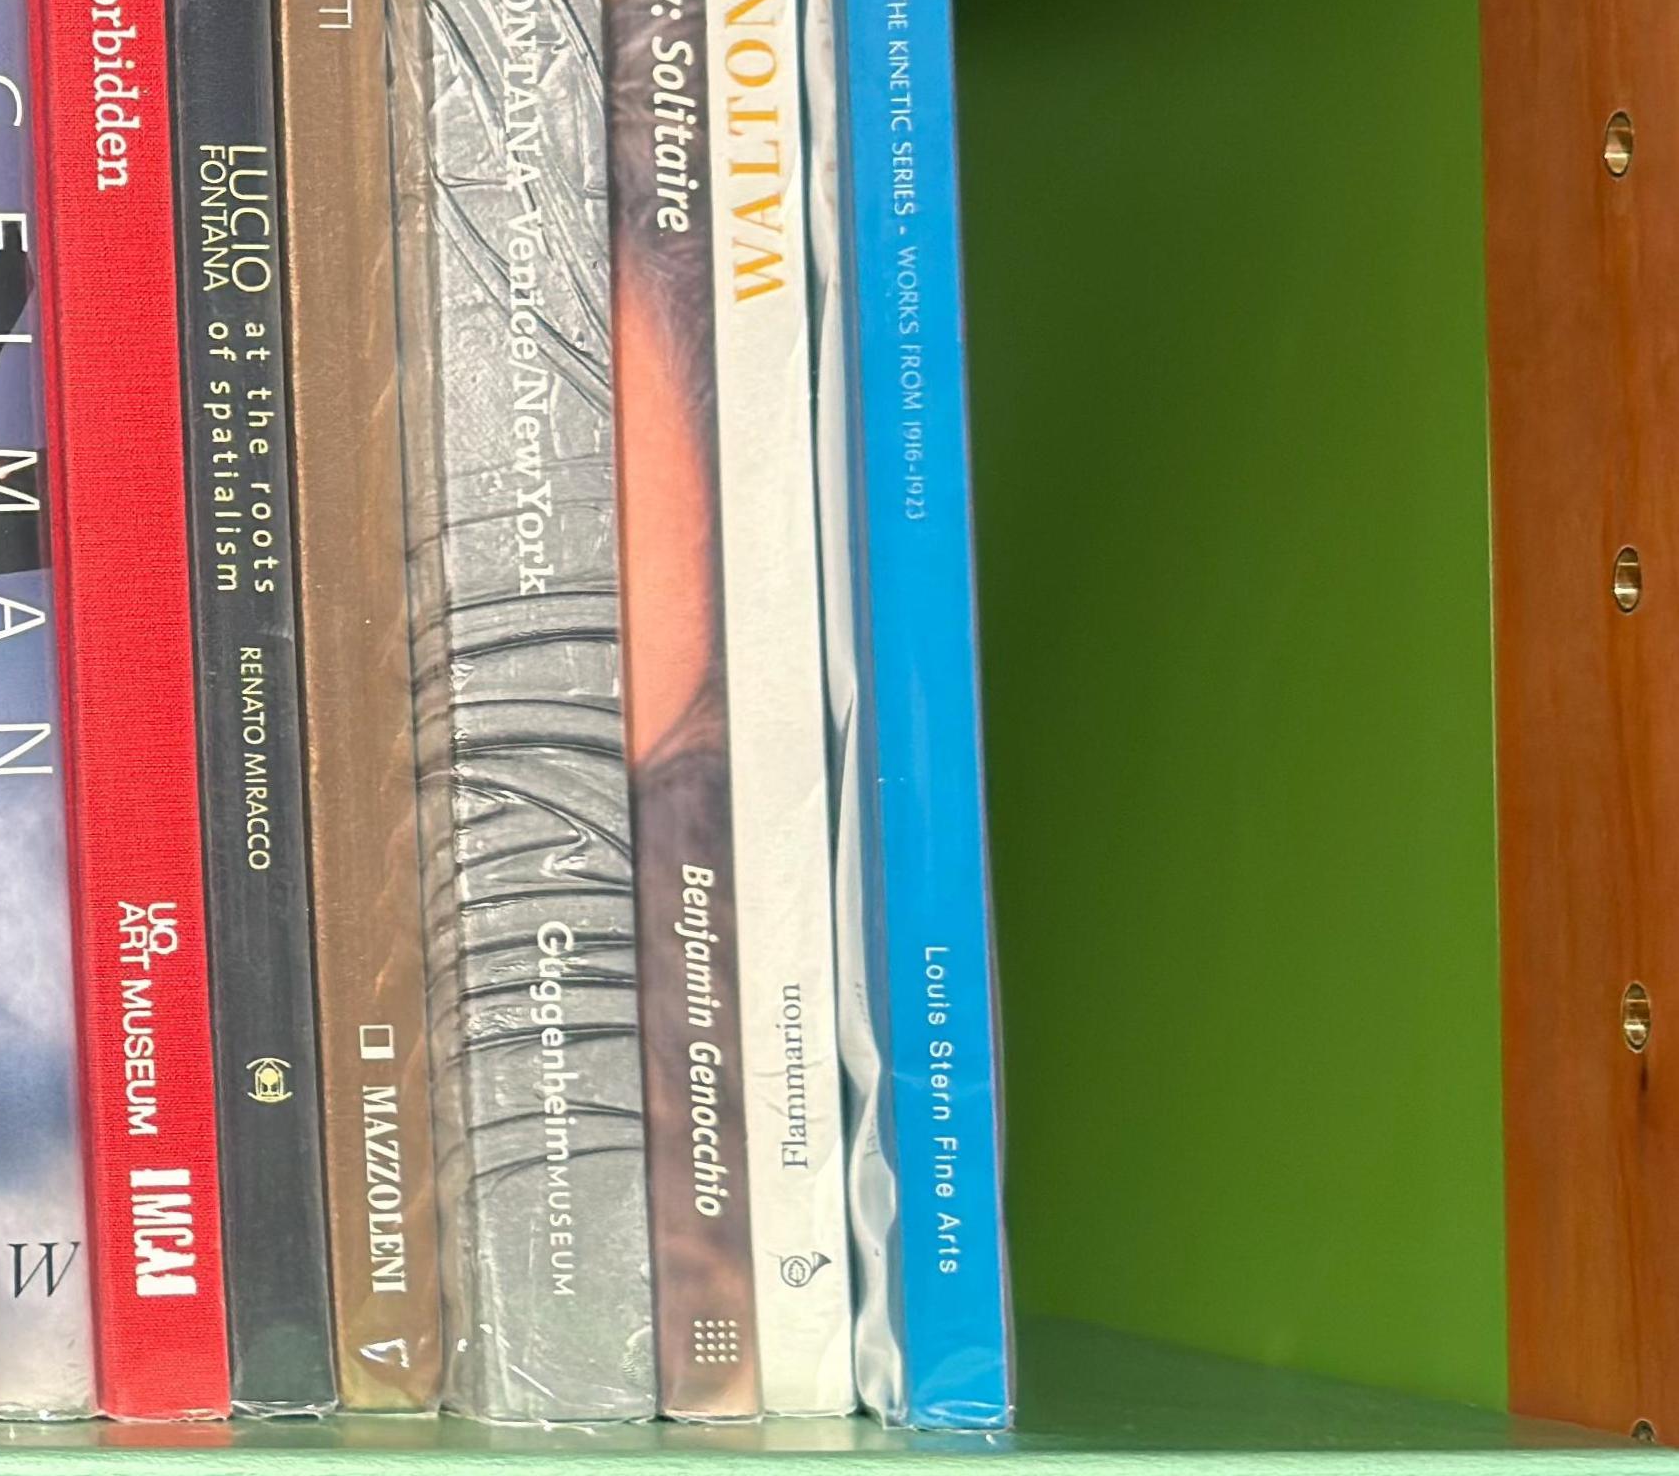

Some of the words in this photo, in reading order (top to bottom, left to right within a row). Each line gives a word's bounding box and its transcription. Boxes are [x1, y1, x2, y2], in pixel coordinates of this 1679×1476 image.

[652, 36, 695, 232] Solitaire
[889, 41, 911, 130] KINETIC
[200, 145, 229, 291] FONTANA
[229, 146, 271, 291] LUCIO
[892, 142, 914, 215] SERIES
[897, 246, 919, 335] WORKS
[900, 344, 925, 411] FROM
[239, 645, 263, 744] RENATO
[243, 752, 270, 871] MIRACCO
[675, 865, 721, 1027] Benjamin
[924, 945, 951, 1025] Louis
[781, 984, 808, 1168] Flammarion
[928, 1041, 953, 1121] Stern
[689, 1042, 728, 1216] Genocchio
[934, 1136, 957, 1197] Fine
[363, 1086, 406, 1292] MAZZOLENI
[938, 1213, 960, 1272] Arts
